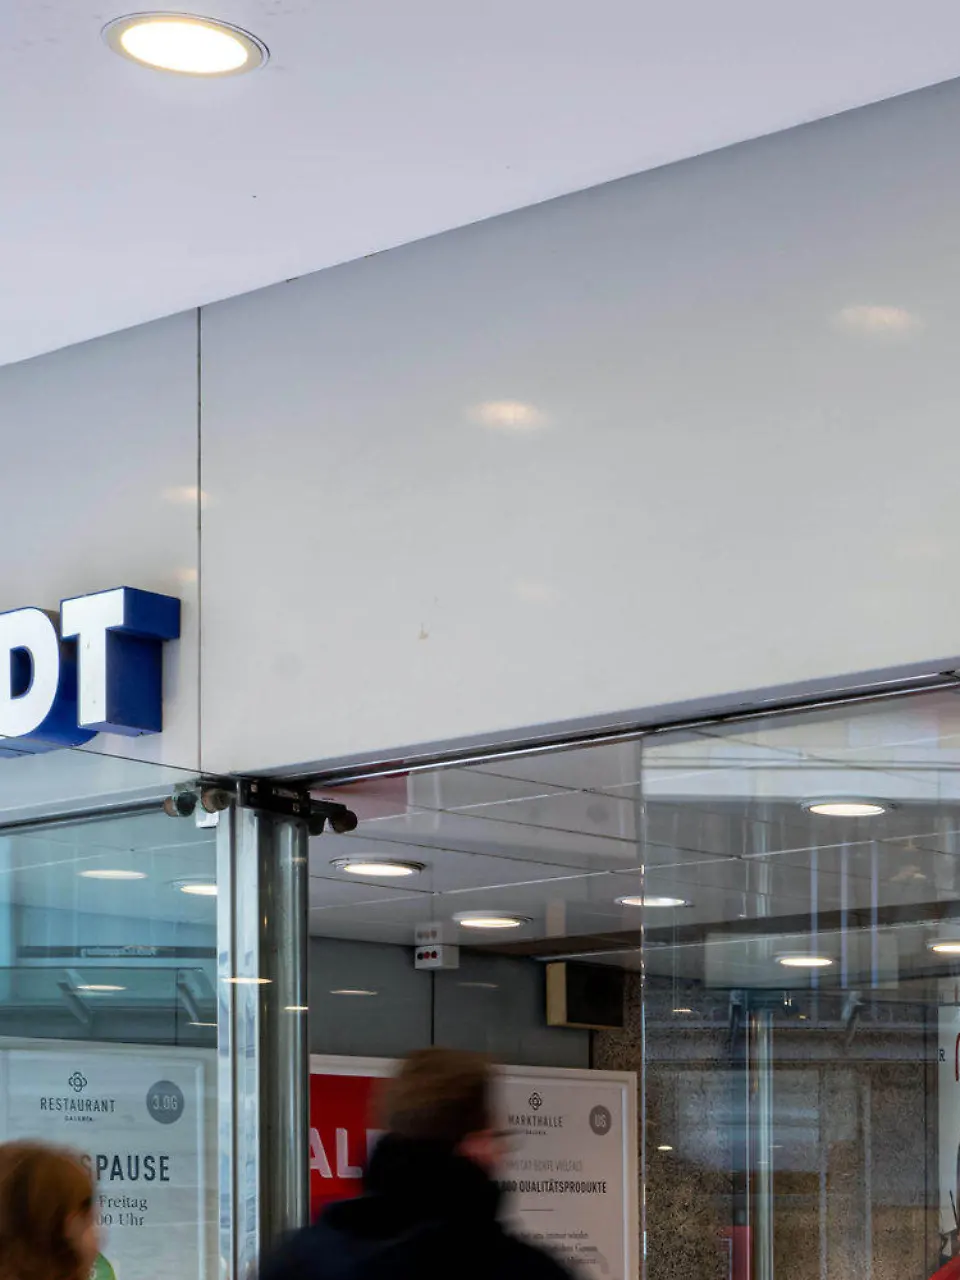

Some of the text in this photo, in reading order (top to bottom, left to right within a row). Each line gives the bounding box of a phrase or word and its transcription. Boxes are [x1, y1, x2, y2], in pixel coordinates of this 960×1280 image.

[0, 586, 125, 738] DT
[40, 1097, 116, 1113] RESTAURANT
[508, 1114, 564, 1128] MARKTHALLE
[310, 1127, 385, 1178] AL
[519, 1178, 607, 1193] QUALITÄTSPRODUKTE
[98, 1194, 148, 1211] Freitag
[119, 1212, 144, 1226] Uhr
